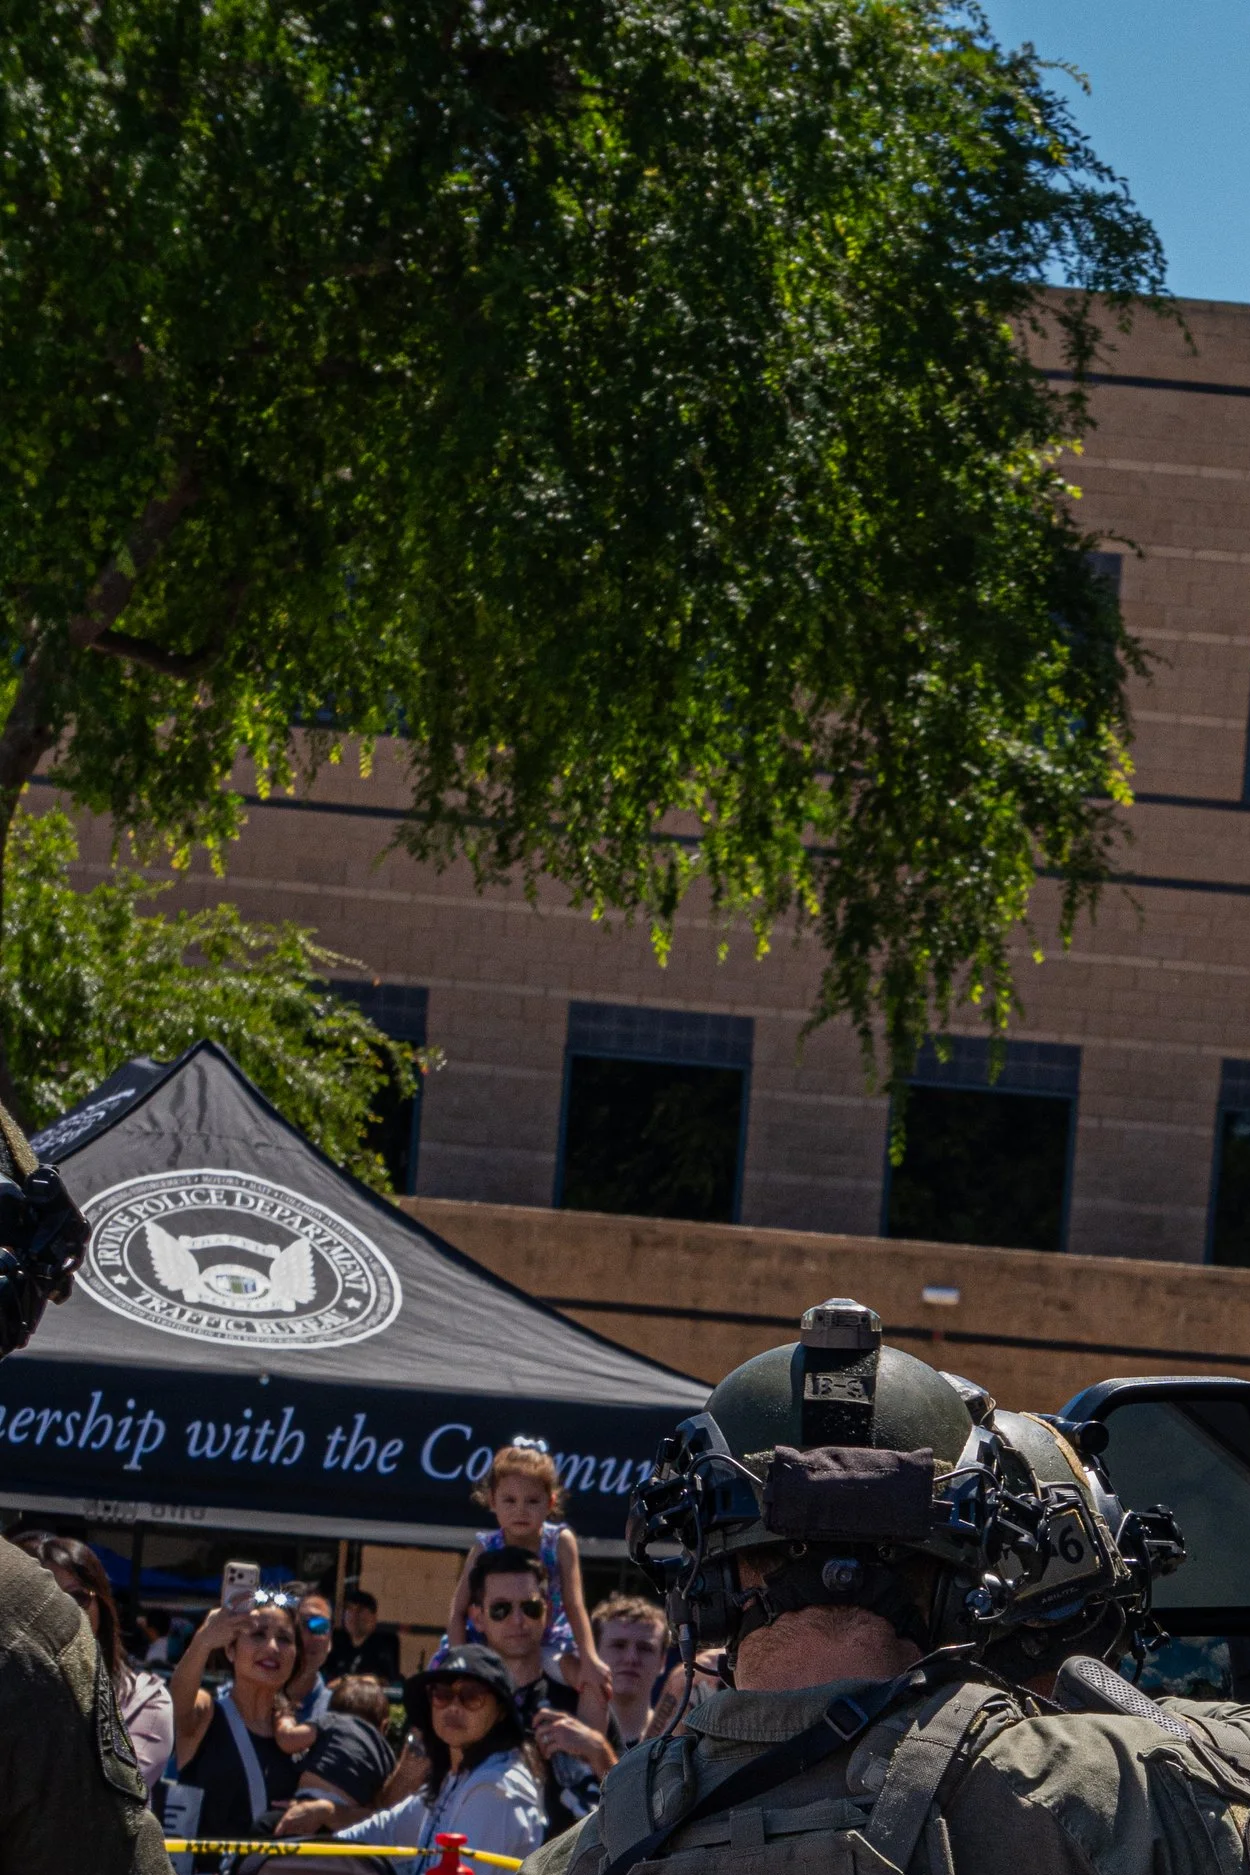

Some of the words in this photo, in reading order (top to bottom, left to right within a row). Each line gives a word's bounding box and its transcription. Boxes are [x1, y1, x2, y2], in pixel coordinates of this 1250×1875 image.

[97, 1211, 139, 1267] IRVINE
[131, 1188, 227, 1221] POLICE
[232, 1191, 369, 1294] DEPARTMENT
[132, 1290, 248, 1334] TRAFFIC
[251, 1308, 351, 1335] BUREAU
[185, 1406, 306, 1466] with
[322, 1412, 404, 1474] the
